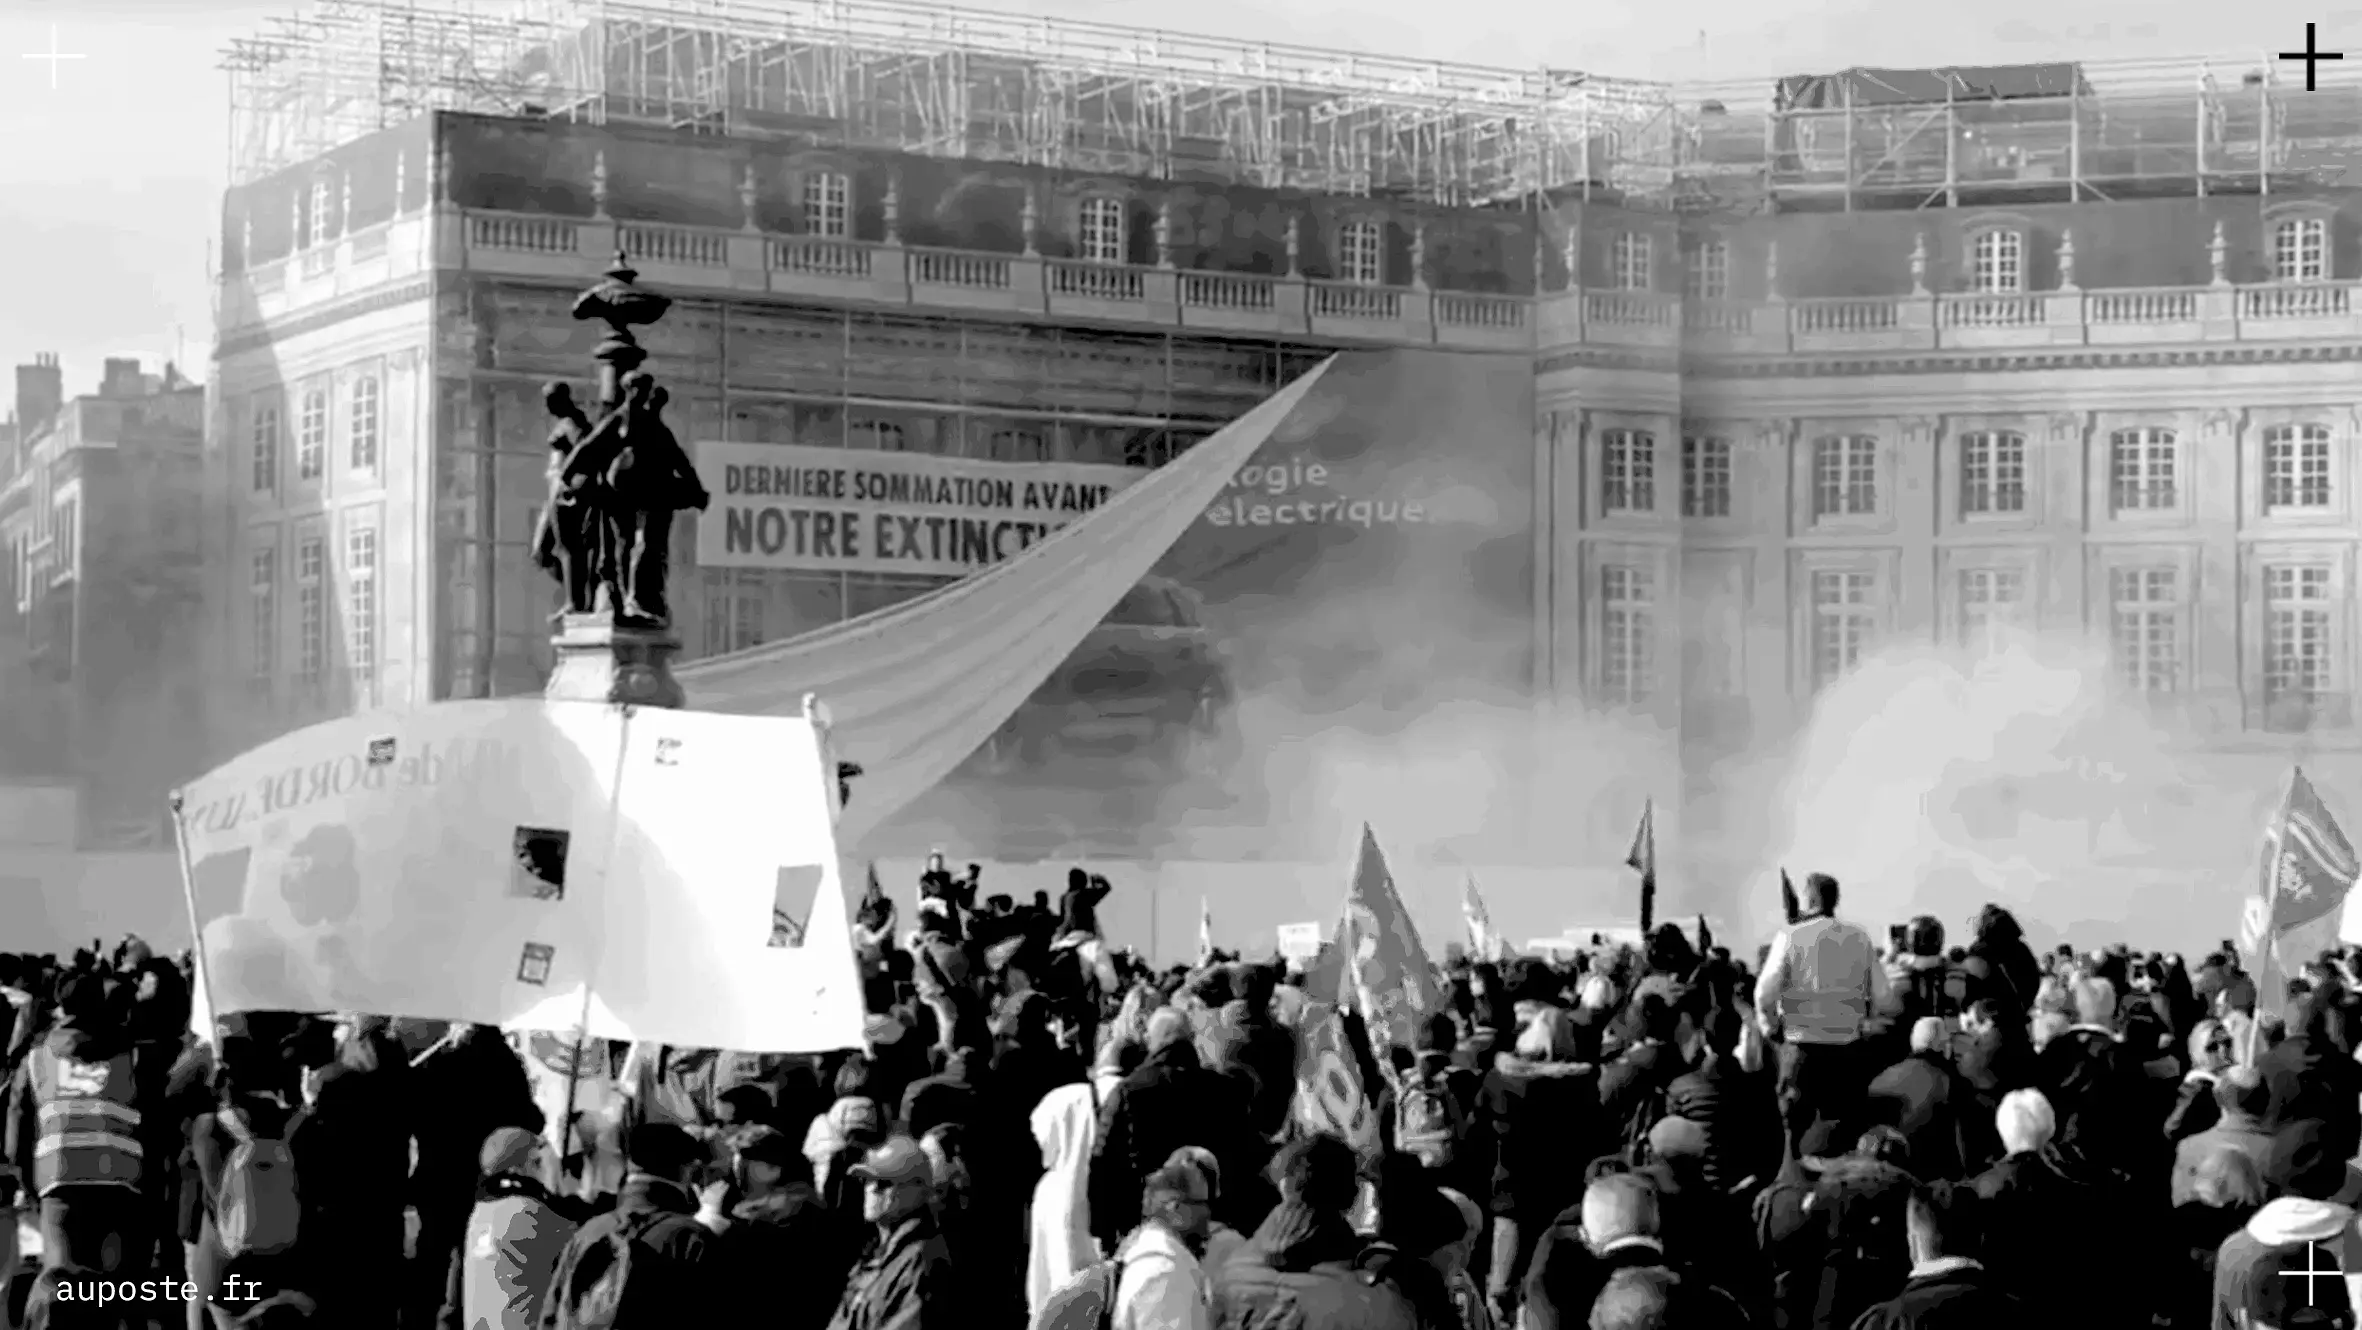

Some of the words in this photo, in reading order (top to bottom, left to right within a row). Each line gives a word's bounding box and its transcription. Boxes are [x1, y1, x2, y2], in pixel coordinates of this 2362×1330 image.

[725, 464, 846, 498] DERNIERE
[854, 471, 1012, 508] SOMMATION
[725, 507, 860, 557] NOTRE
